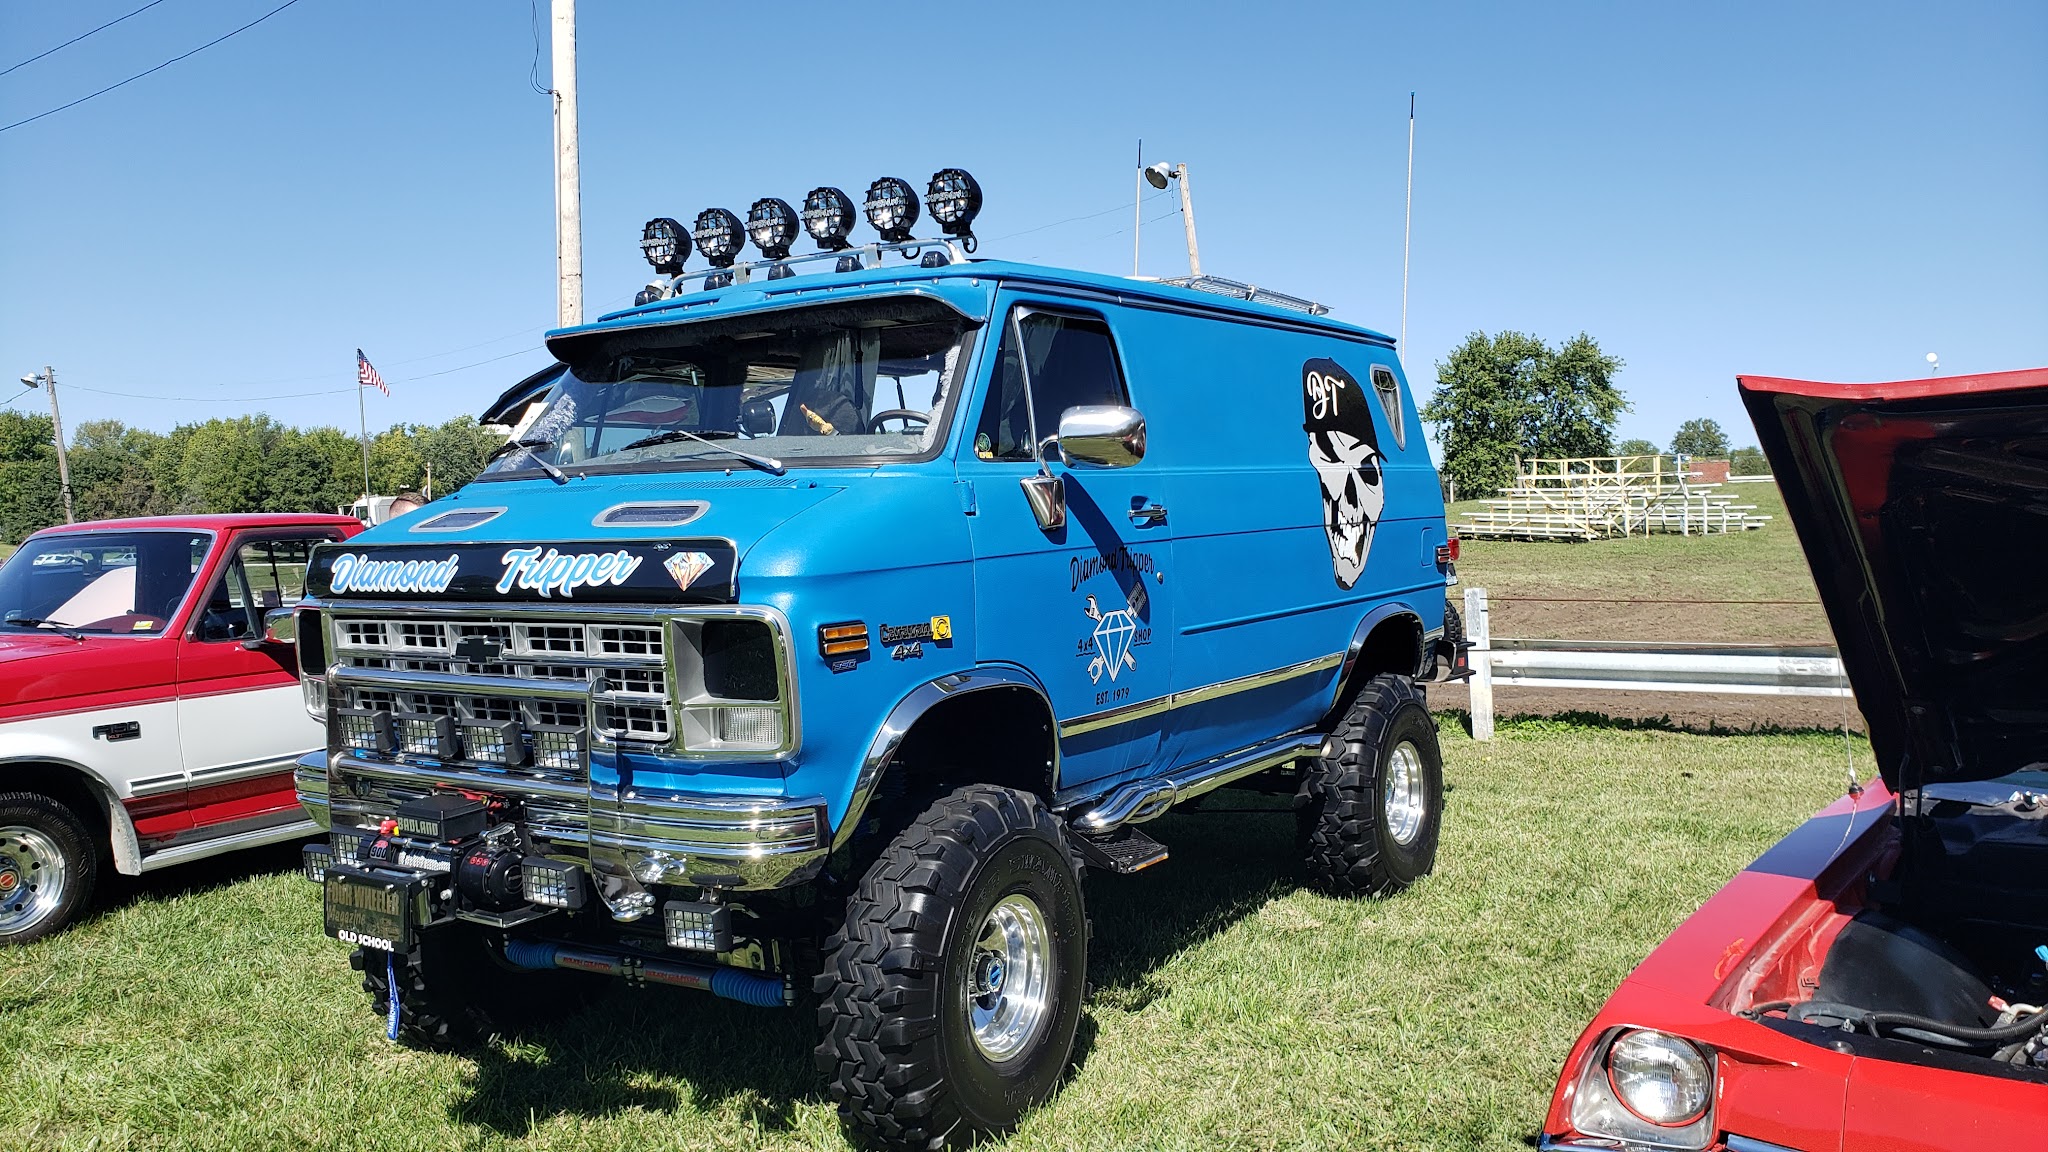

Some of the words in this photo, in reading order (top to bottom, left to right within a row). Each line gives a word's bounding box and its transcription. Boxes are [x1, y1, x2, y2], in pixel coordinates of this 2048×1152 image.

[331, 553, 459, 595] Diamond
[495, 546, 643, 598] Tripper
[1070, 548, 1118, 592] Diamond
[1119, 546, 1155, 577] Tripper
[1077, 637, 1094, 653] 4x4
[1134, 628, 1152, 643] SHOP
[891, 641, 923, 660] 4x4
[1095, 691, 1110, 706] EST.
[1112, 687, 1130, 702] 1979
[398, 816, 439, 837] BADLAND
[327, 878, 353, 906] FOUR
[354, 885, 400, 916] WHEELER
[338, 929, 357, 943] OLD
[358, 933, 394, 952] SCHOOL
